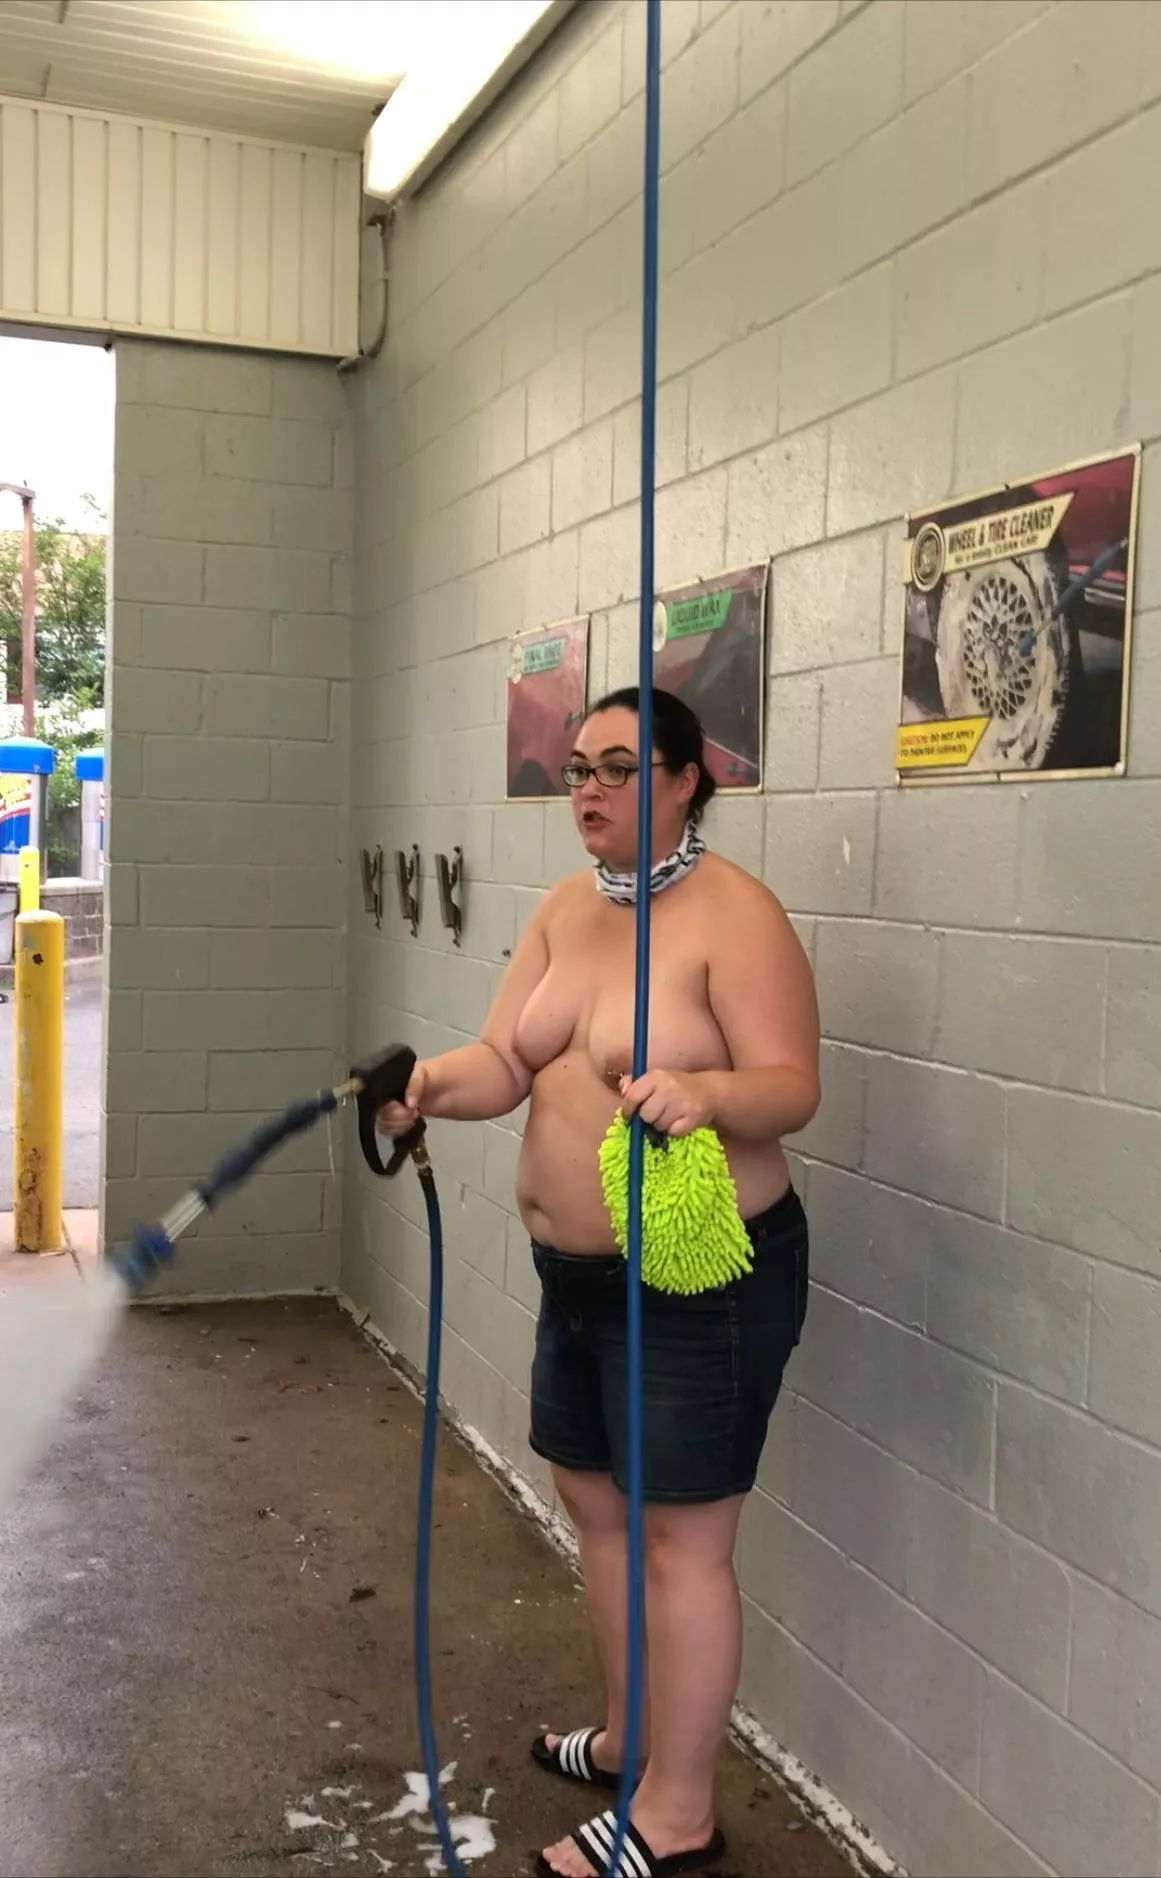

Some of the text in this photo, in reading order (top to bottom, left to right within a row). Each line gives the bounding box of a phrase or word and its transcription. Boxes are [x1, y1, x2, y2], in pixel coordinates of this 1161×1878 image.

[949, 527, 976, 554] WHEEL
[978, 523, 985, 546] &
[988, 517, 1008, 543] TIRE
[1009, 505, 1055, 537] CLEANER
[941, 730, 954, 741] NOT
[955, 729, 975, 740] APPLY
